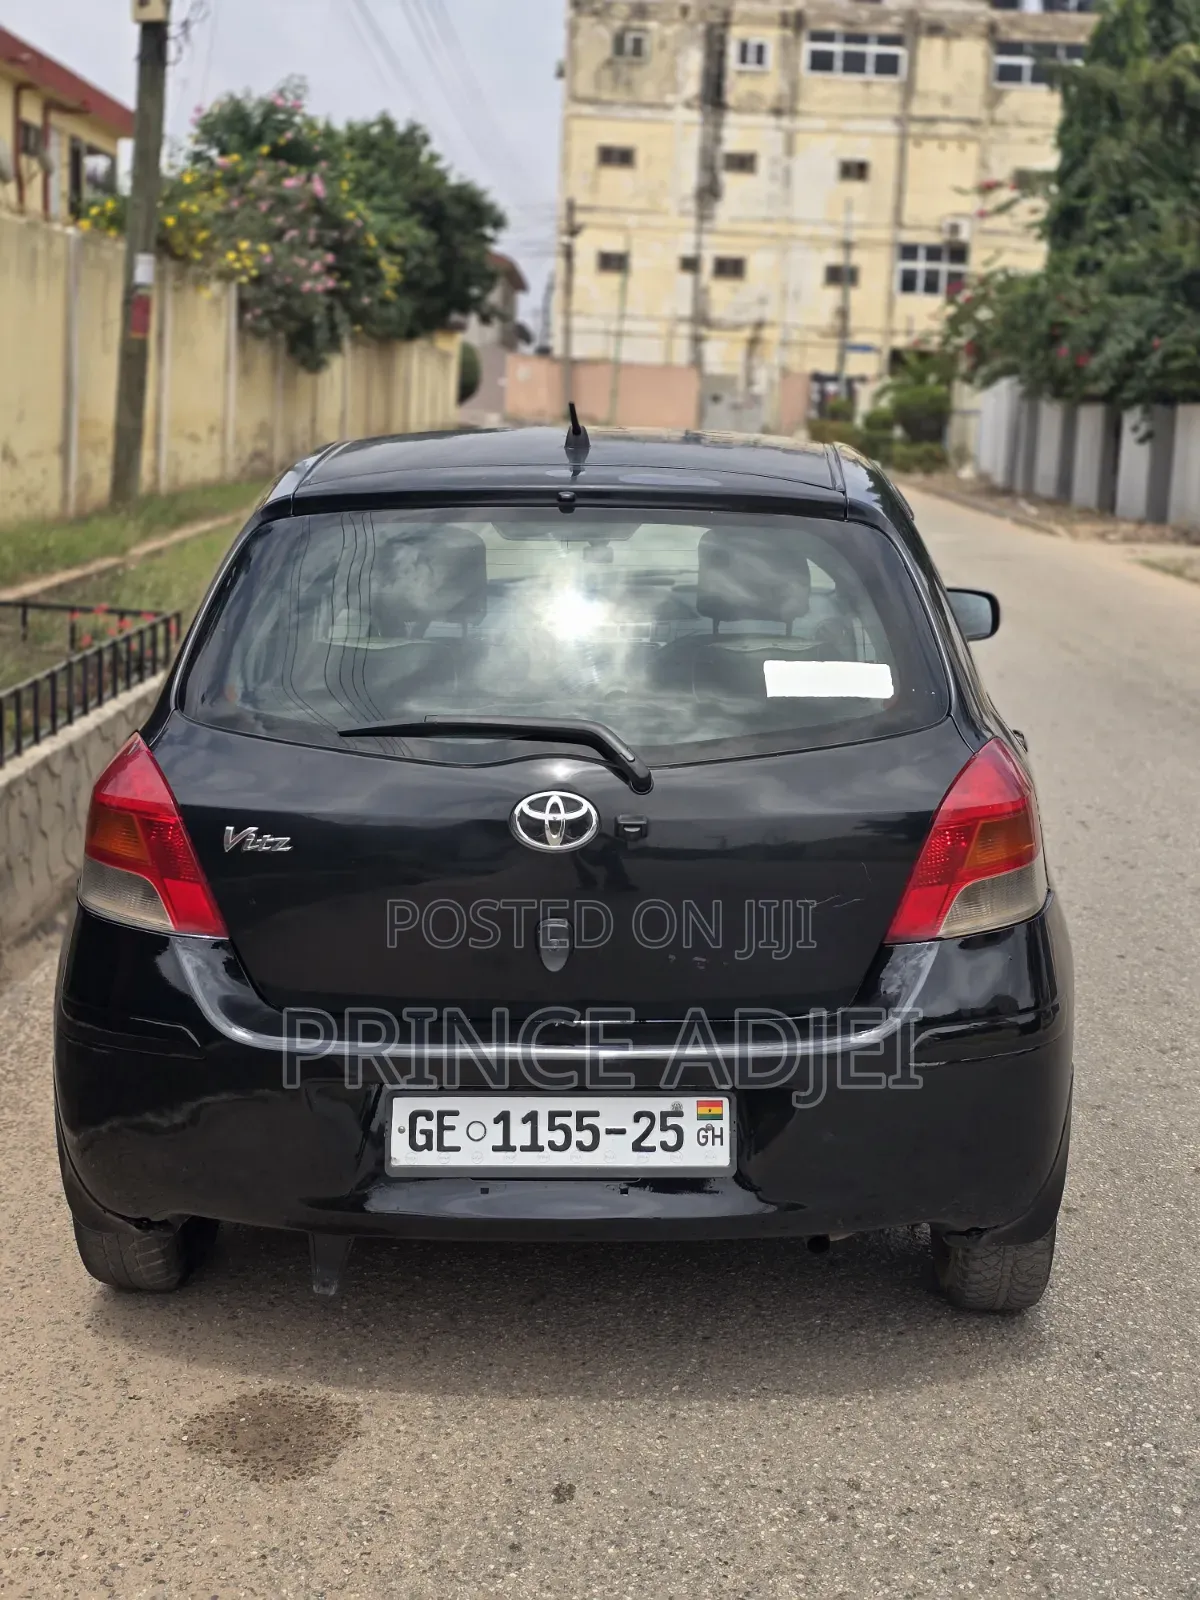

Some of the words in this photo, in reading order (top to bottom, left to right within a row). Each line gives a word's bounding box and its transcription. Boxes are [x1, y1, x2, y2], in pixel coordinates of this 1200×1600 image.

[223, 826, 294, 853] Vitz
[408, 1109, 461, 1152] GE
[491, 1109, 684, 1153] 1155-25
[696, 1127, 724, 1147] GH
